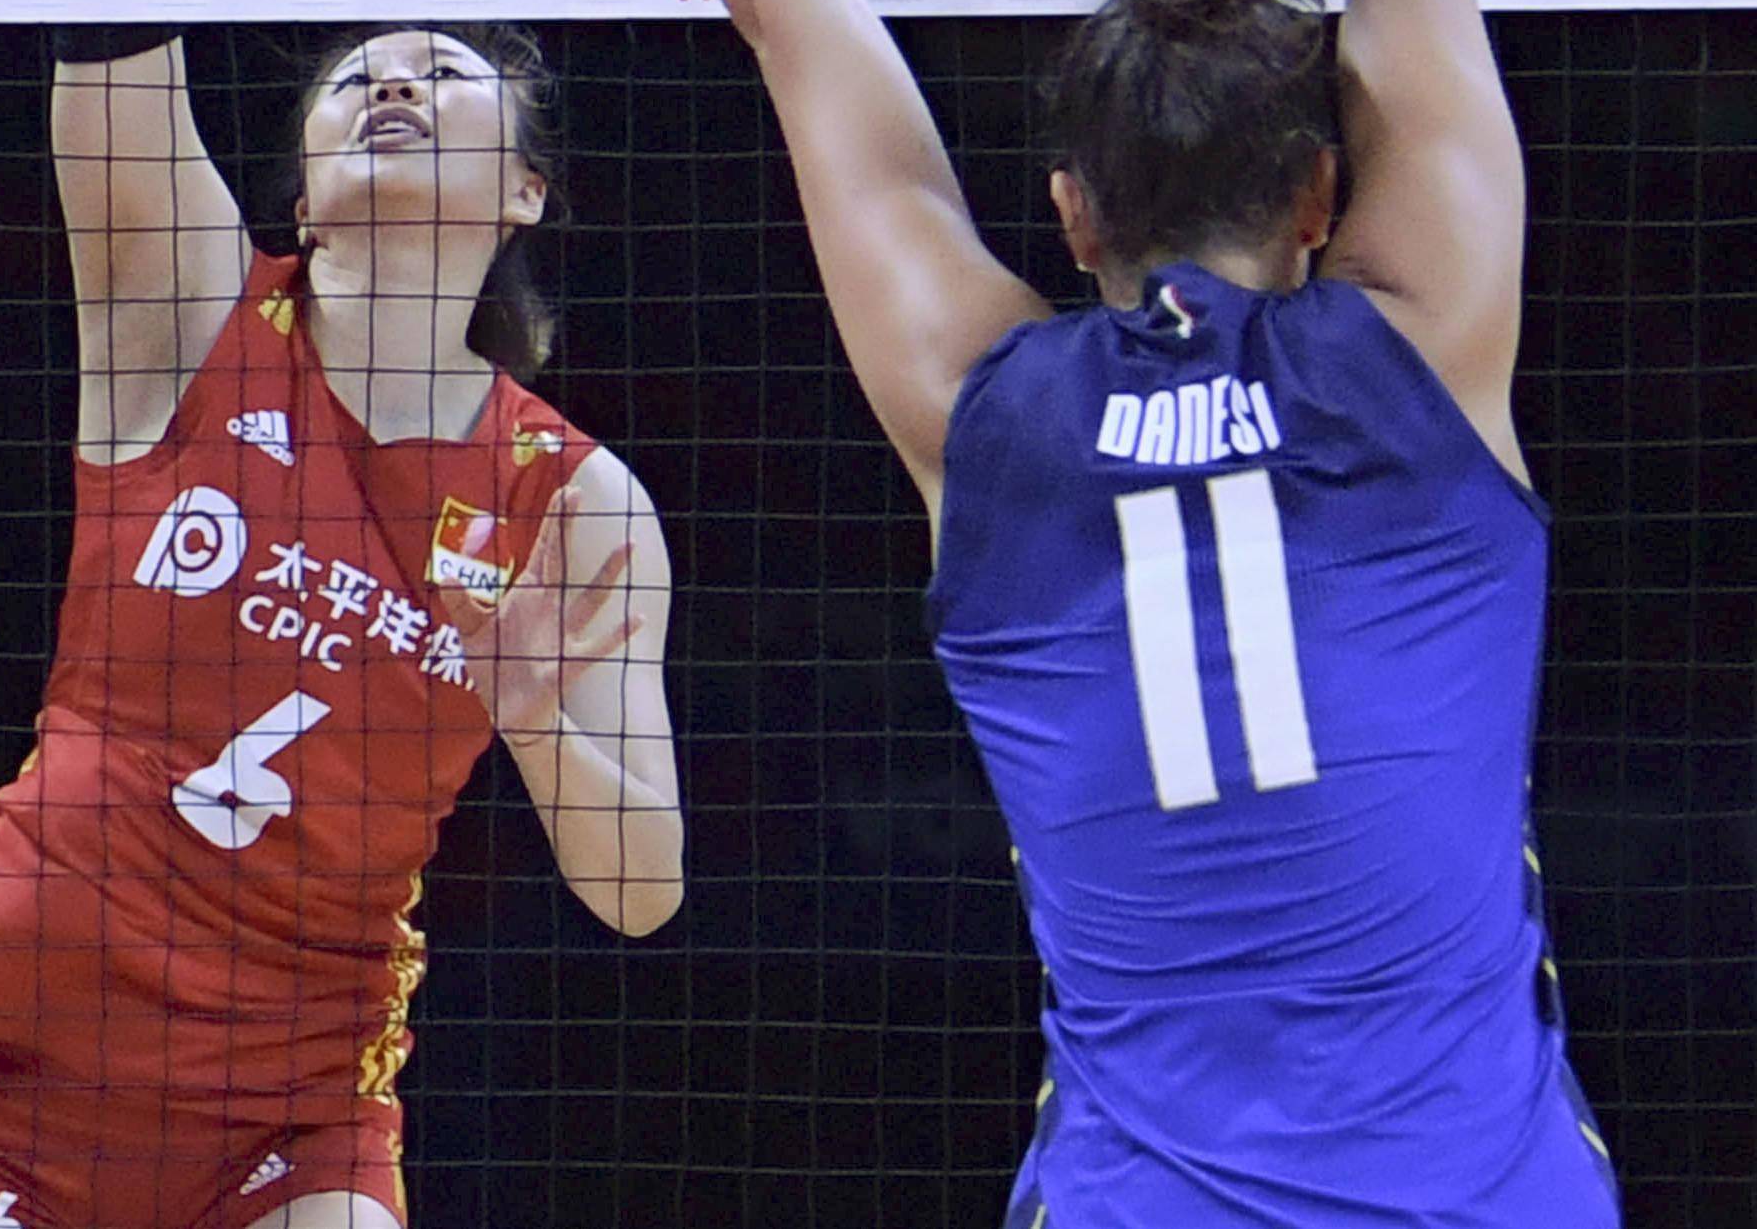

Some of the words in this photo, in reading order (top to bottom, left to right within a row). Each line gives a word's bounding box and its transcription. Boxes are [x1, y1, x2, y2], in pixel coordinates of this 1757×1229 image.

[1096, 374, 1281, 465] DANESI
[239, 595, 352, 671] CPIC
[256, 541, 473, 691] 太平洋保
[1114, 468, 1318, 811] 11
[172, 690, 332, 849] 6
